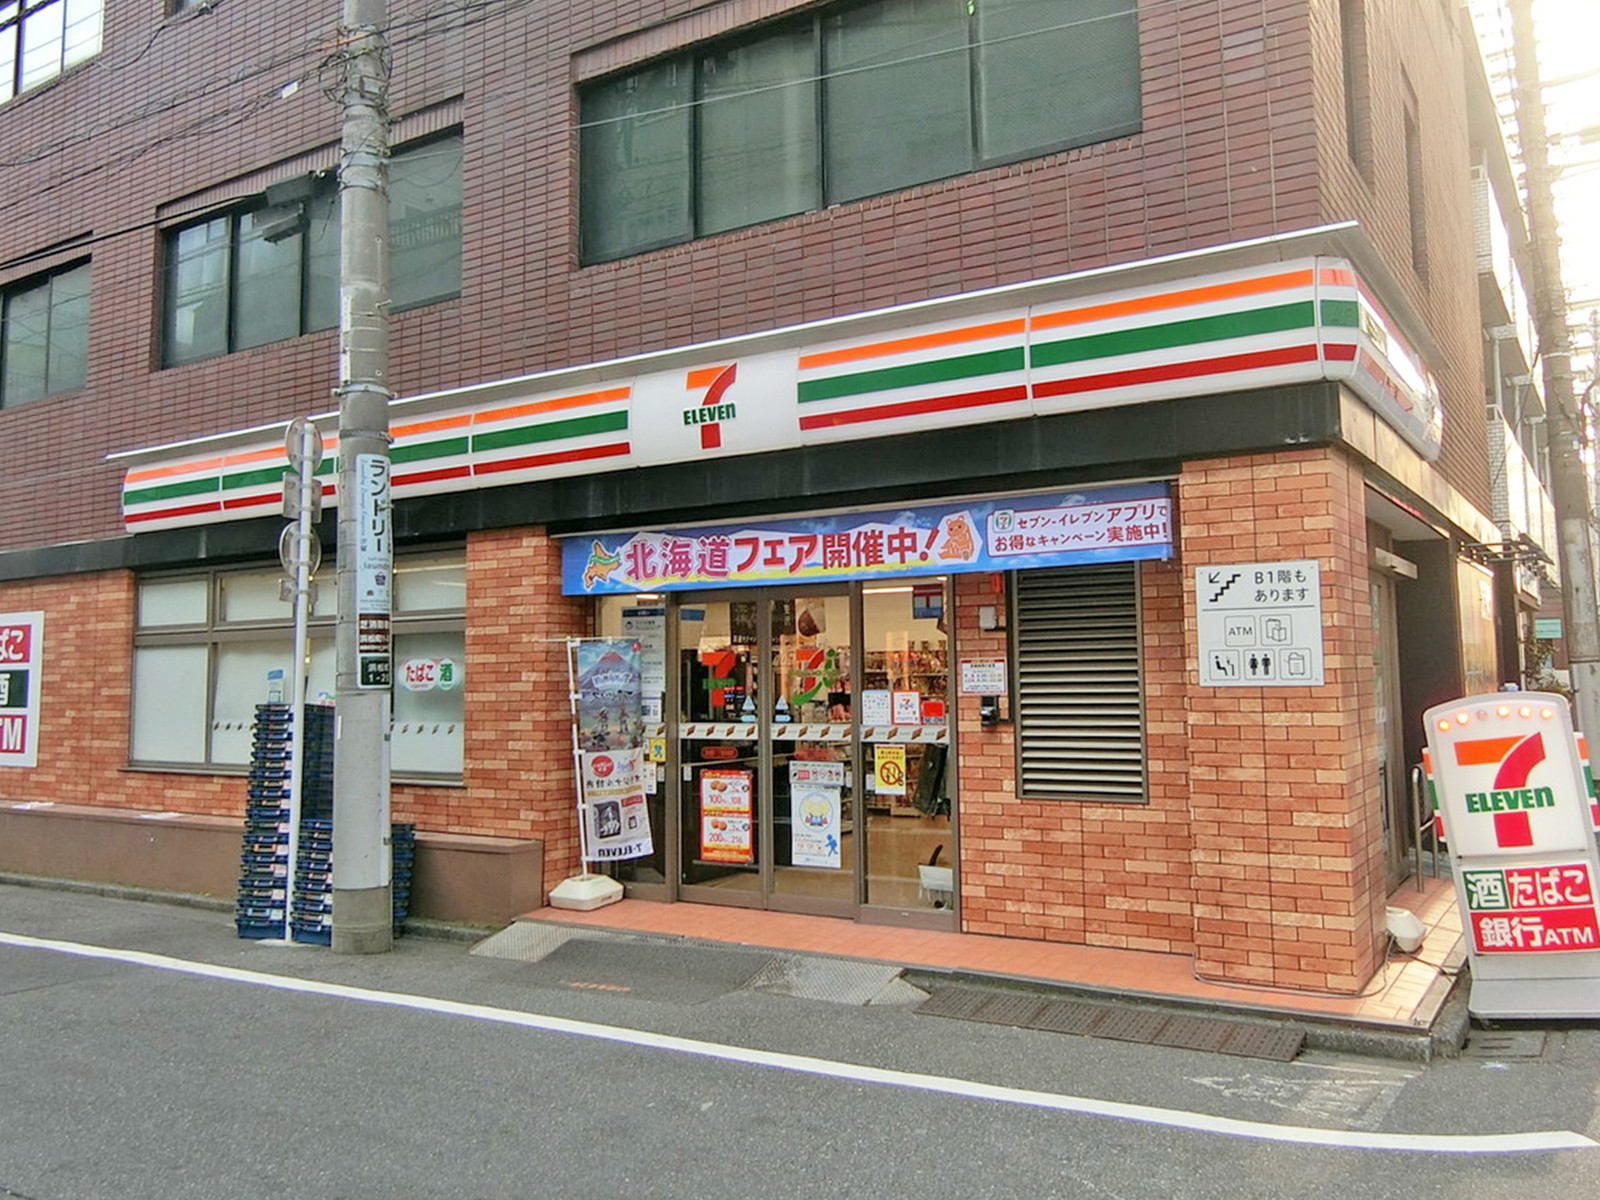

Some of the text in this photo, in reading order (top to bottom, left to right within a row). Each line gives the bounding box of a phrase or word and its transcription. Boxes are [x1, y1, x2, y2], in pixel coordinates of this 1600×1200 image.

[370, 459, 387, 552] ランドリー
[994, 522, 1168, 551] お得なキャンペーン実施中!
[624, 526, 940, 581] 北海道フェア開催中!
[1254, 570, 1307, 584] B1階も
[1254, 587, 1309, 602] あります
[1228, 626, 1253, 636] ATM
[406, 663, 453, 682] たばこ 酒
[0, 717, 22, 751] M
[1454, 732, 1546, 847] 7
[1467, 868, 1590, 909] 酒 たばこ
